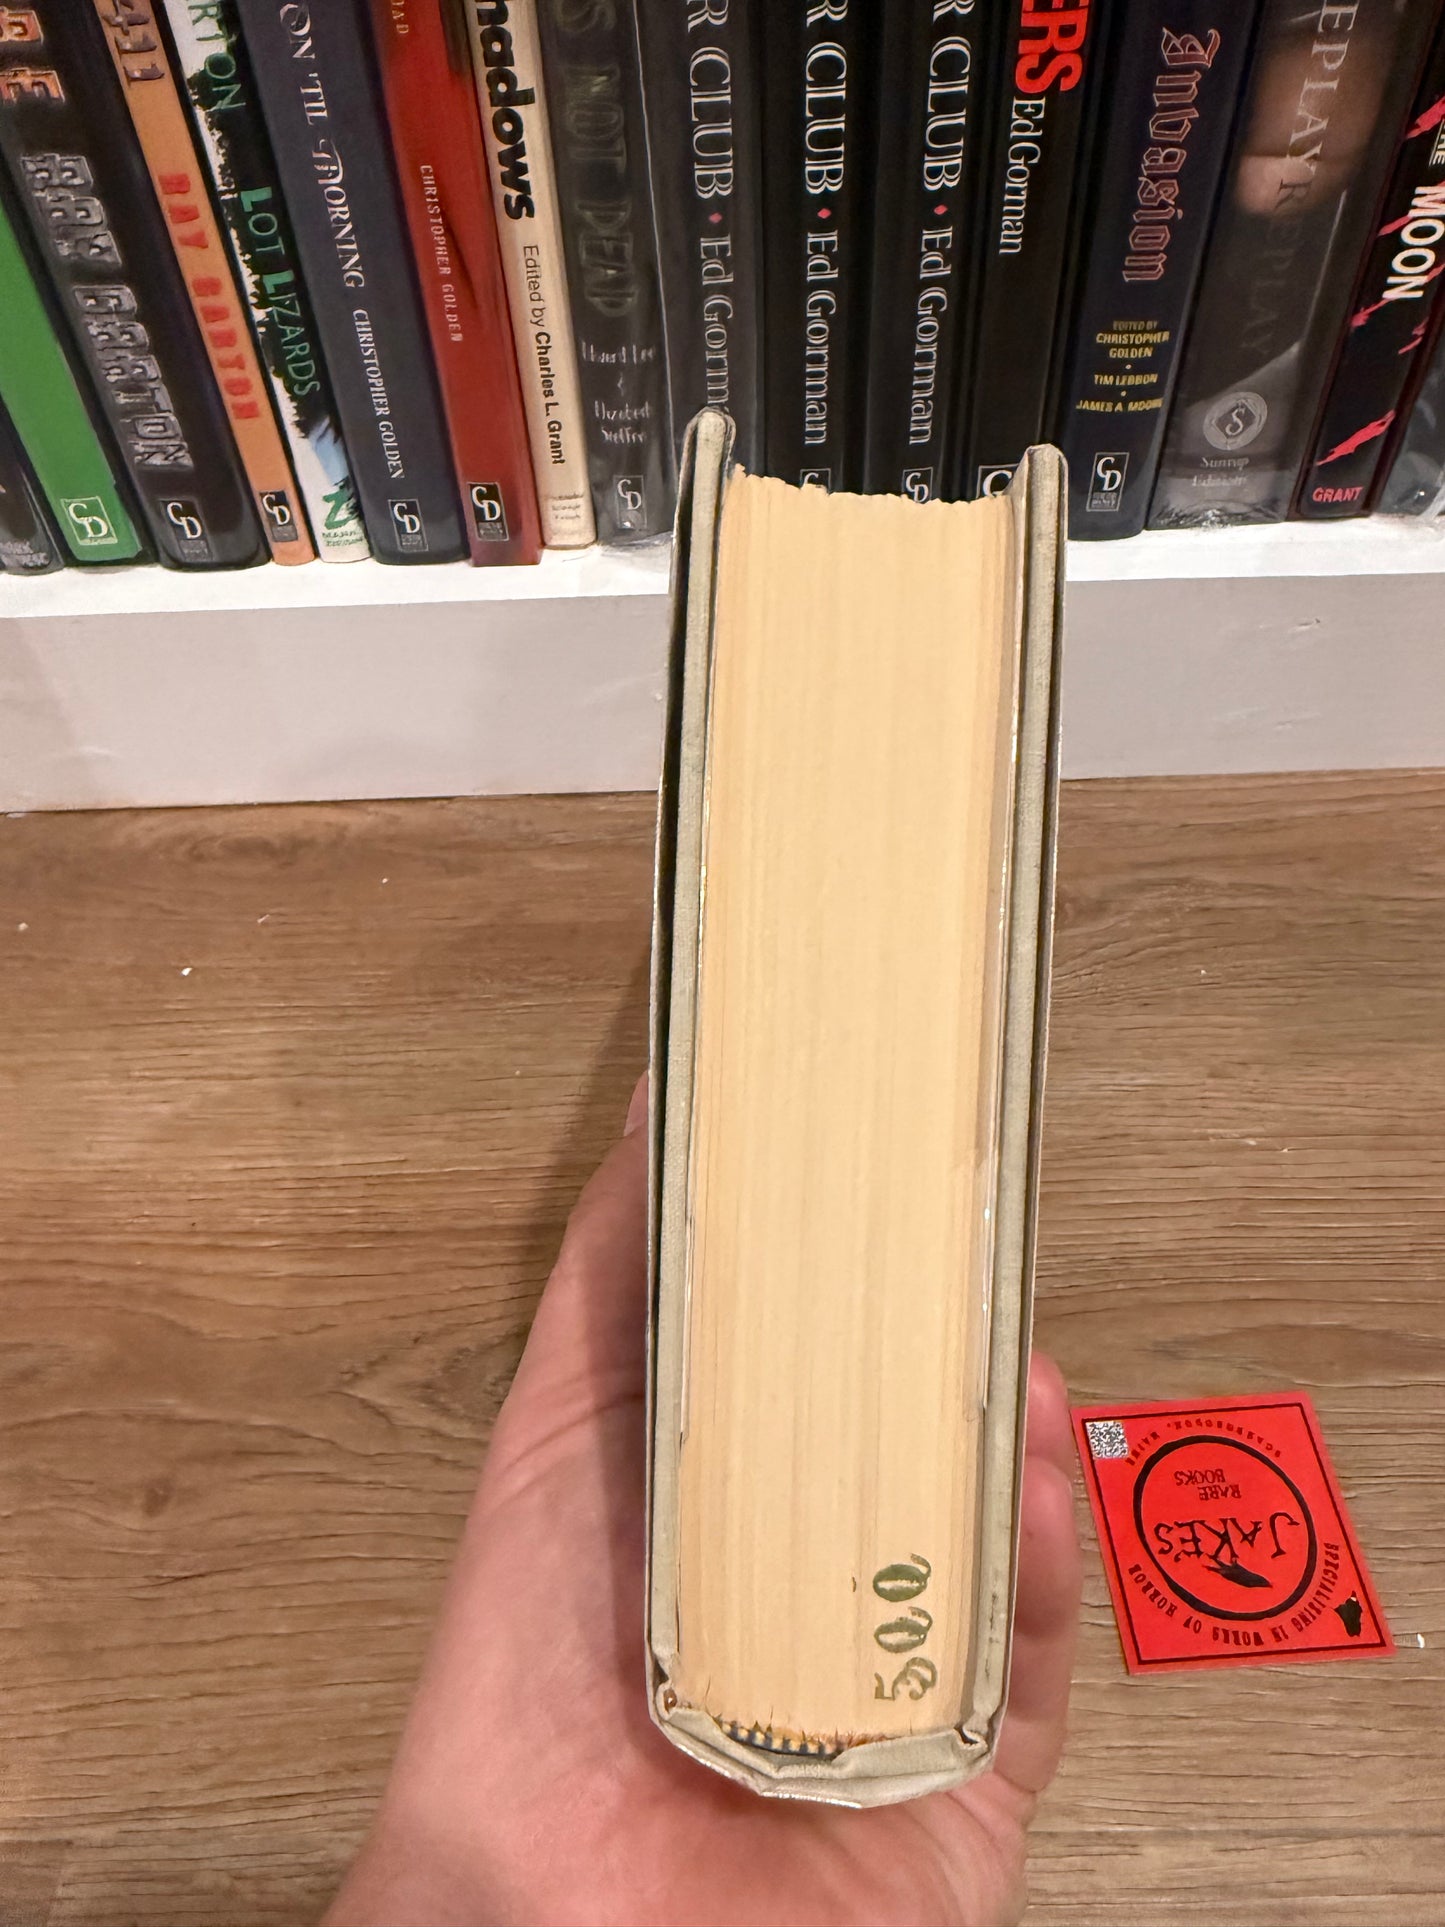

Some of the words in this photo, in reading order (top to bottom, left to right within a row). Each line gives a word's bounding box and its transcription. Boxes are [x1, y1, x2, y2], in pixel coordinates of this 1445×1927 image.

[1015, 0, 1089, 94] RS
[689, 47, 734, 200] CLUB
[805, 41, 848, 195] CLUB
[923, 36, 972, 192] CLUB
[1010, 96, 1046, 139] Ed
[240, 187, 285, 255] LOT
[312, 138, 365, 289] MORNING
[999, 142, 1041, 255] Gorman
[419, 165, 452, 276] CHRISTOPHER
[441, 284, 463, 342] GOLDEN
[700, 233, 735, 286] Ed
[806, 230, 840, 283] Ed
[920, 225, 953, 280] Ed
[1382, 184, 1445, 299] MOON
[523, 245, 545, 302] Edited
[262, 270, 320, 397] LIZARDS
[531, 307, 545, 328] by
[534, 332, 556, 398] Charles
[703, 294, 733, 408] Gorm
[804, 290, 837, 446] Gorman
[909, 287, 948, 446] Gorman
[1109, 347, 1154, 359] GOLDEN
[352, 309, 391, 417] CHRISTOPHER
[378, 420, 405, 480] GOLDEN
[1094, 374, 1114, 386] TIM
[544, 402, 558, 417] L.
[547, 420, 566, 465] Grant
[617, 479, 642, 511] CD
[1096, 456, 1122, 492] CD
[1312, 486, 1363, 503] GRANT
[68, 502, 109, 538] CD
[167, 502, 202, 539] CD
[262, 494, 290, 525] CD
[393, 503, 420, 533] CD
[471, 486, 501, 521] CD
[1173, 1468, 1226, 1485] BOOKS
[1199, 1484, 1242, 1501] RARE
